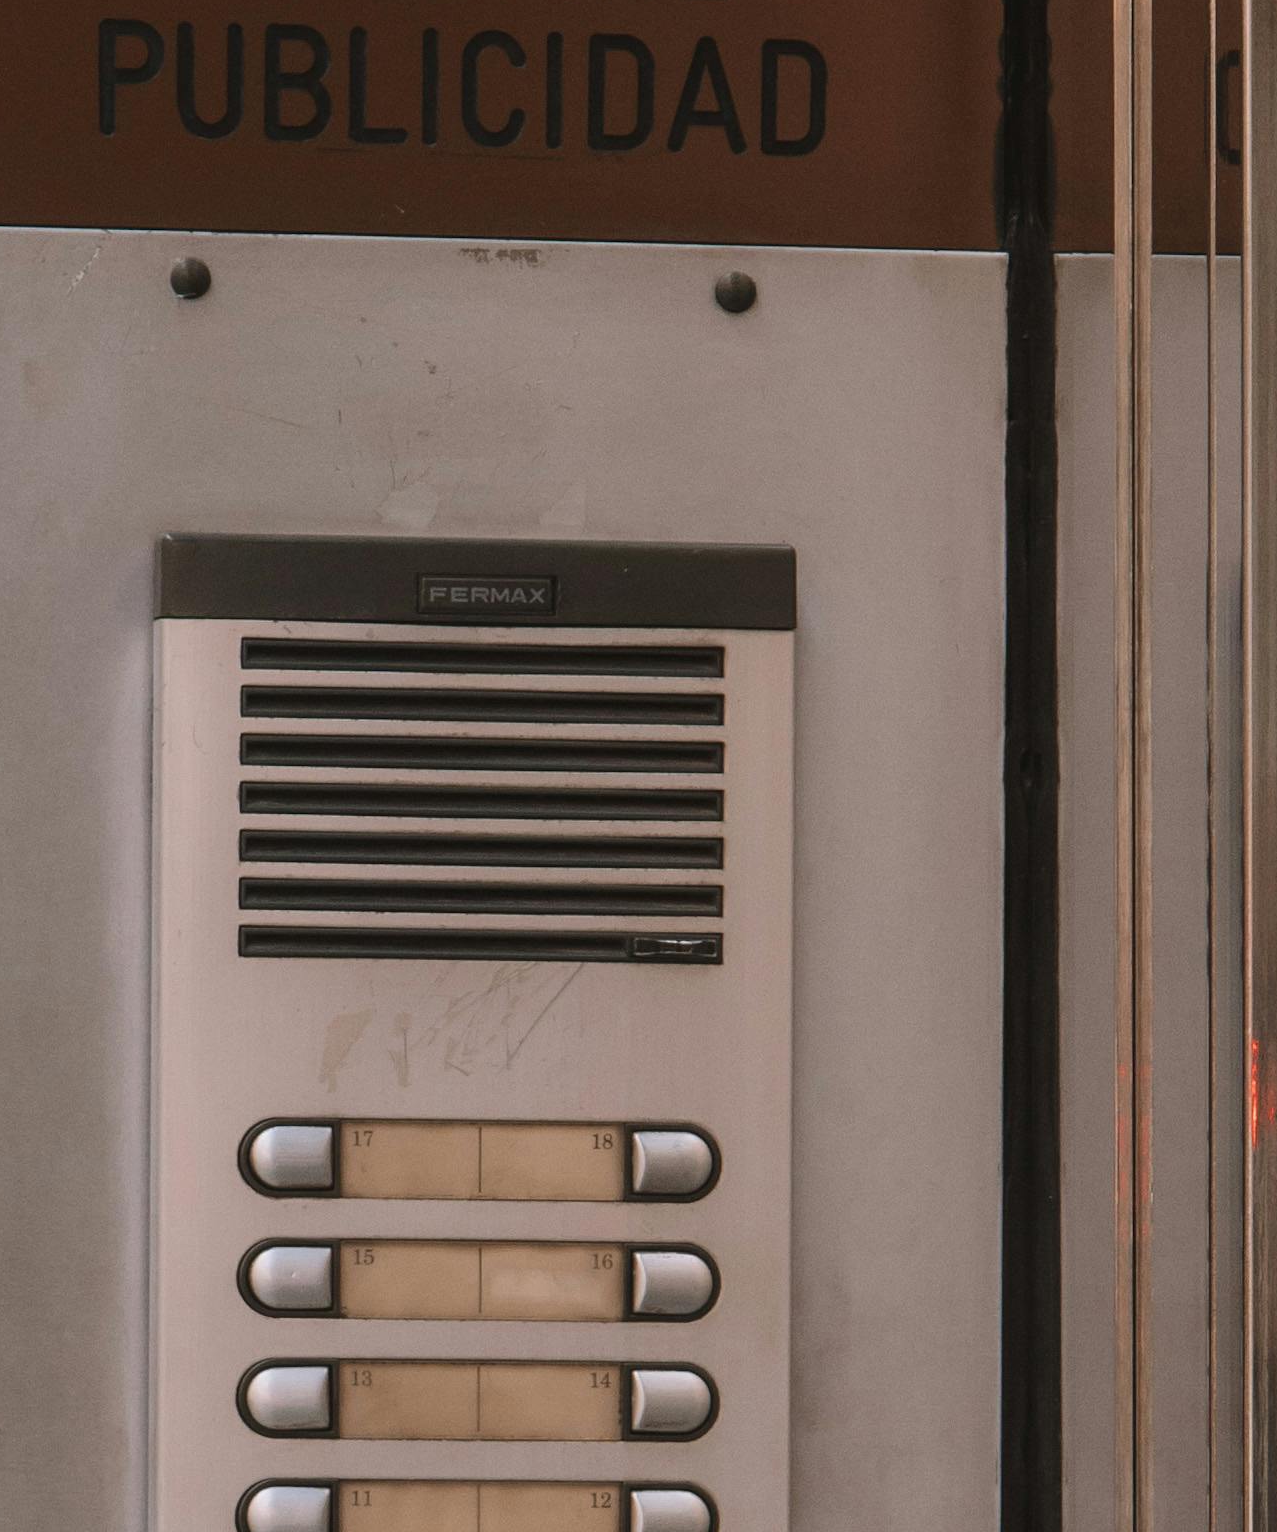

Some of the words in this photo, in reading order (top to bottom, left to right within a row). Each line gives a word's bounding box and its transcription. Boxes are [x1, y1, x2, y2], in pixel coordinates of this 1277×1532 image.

[95, 17, 829, 158] PUBLICIDAD
[428, 586, 546, 604] FERMAX
[351, 1130, 374, 1148] 17
[591, 1133, 614, 1150] 18
[352, 1248, 375, 1266] 15
[591, 1253, 614, 1270] 16
[350, 1370, 373, 1388] 13
[590, 1372, 612, 1389] 14
[351, 1490, 372, 1507] 11
[590, 1492, 612, 1509] 12
